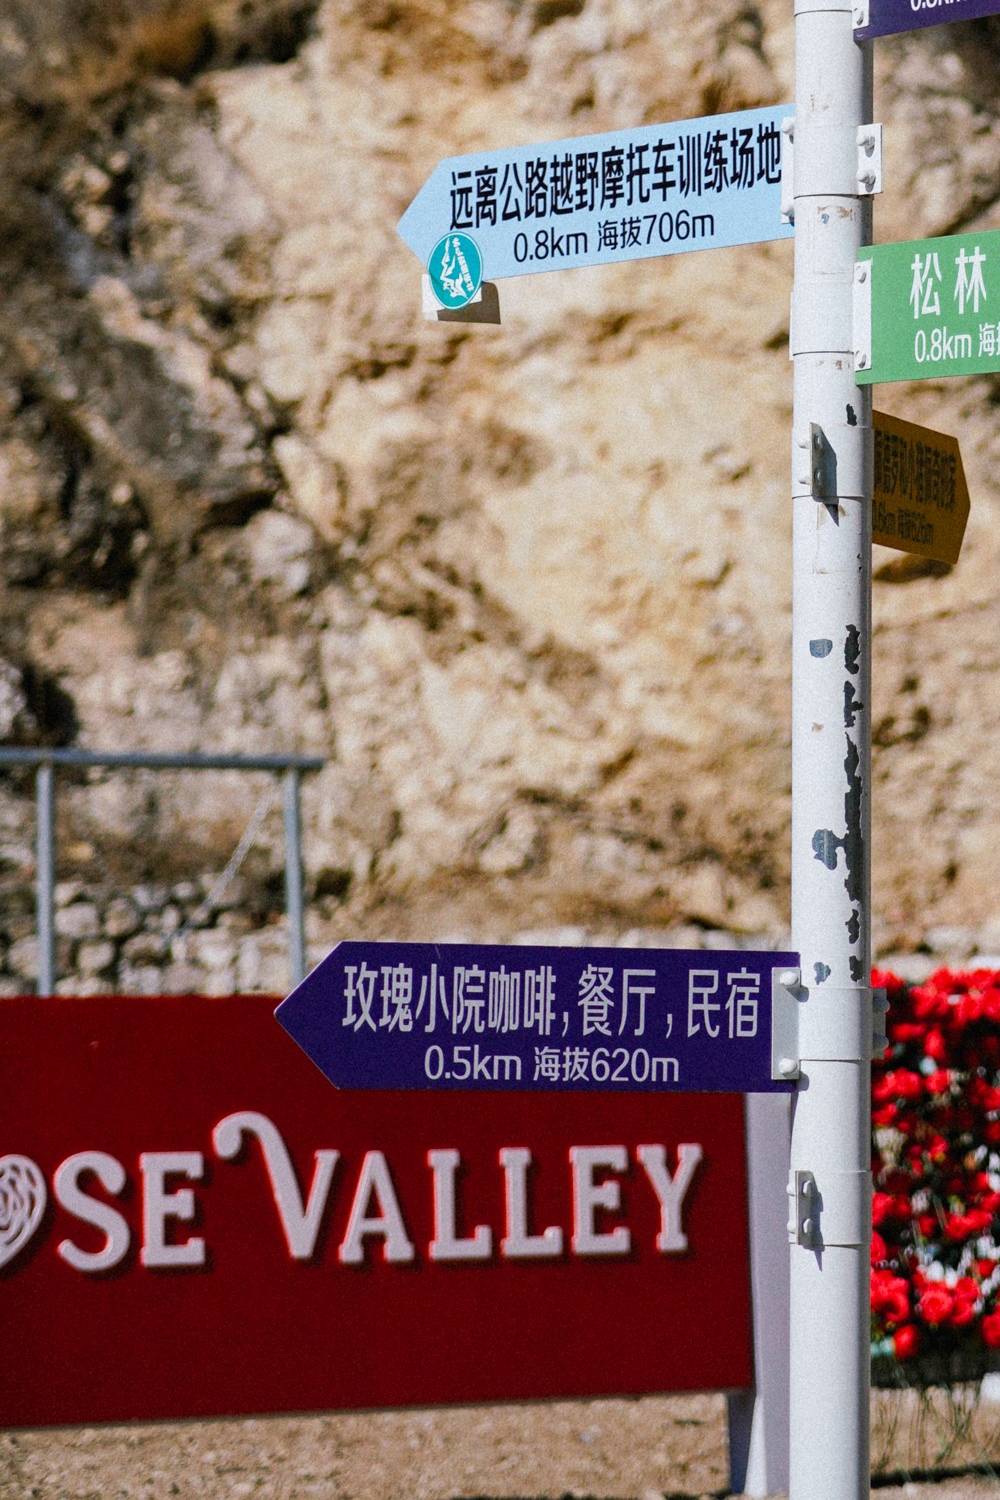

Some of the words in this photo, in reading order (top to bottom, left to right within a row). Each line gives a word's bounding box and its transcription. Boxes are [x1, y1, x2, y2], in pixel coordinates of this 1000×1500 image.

[449, 121, 782, 231] 远离公路越野摩托车训练场地
[513, 226, 588, 263] 0.8km
[597, 209, 715, 252] 海拔706m
[914, 326, 972, 363] 0.8km
[424, 1044, 522, 1081] 0.5km
[532, 1046, 679, 1082] 海拔620m
[213, 1111, 702, 1263] VALLEY
